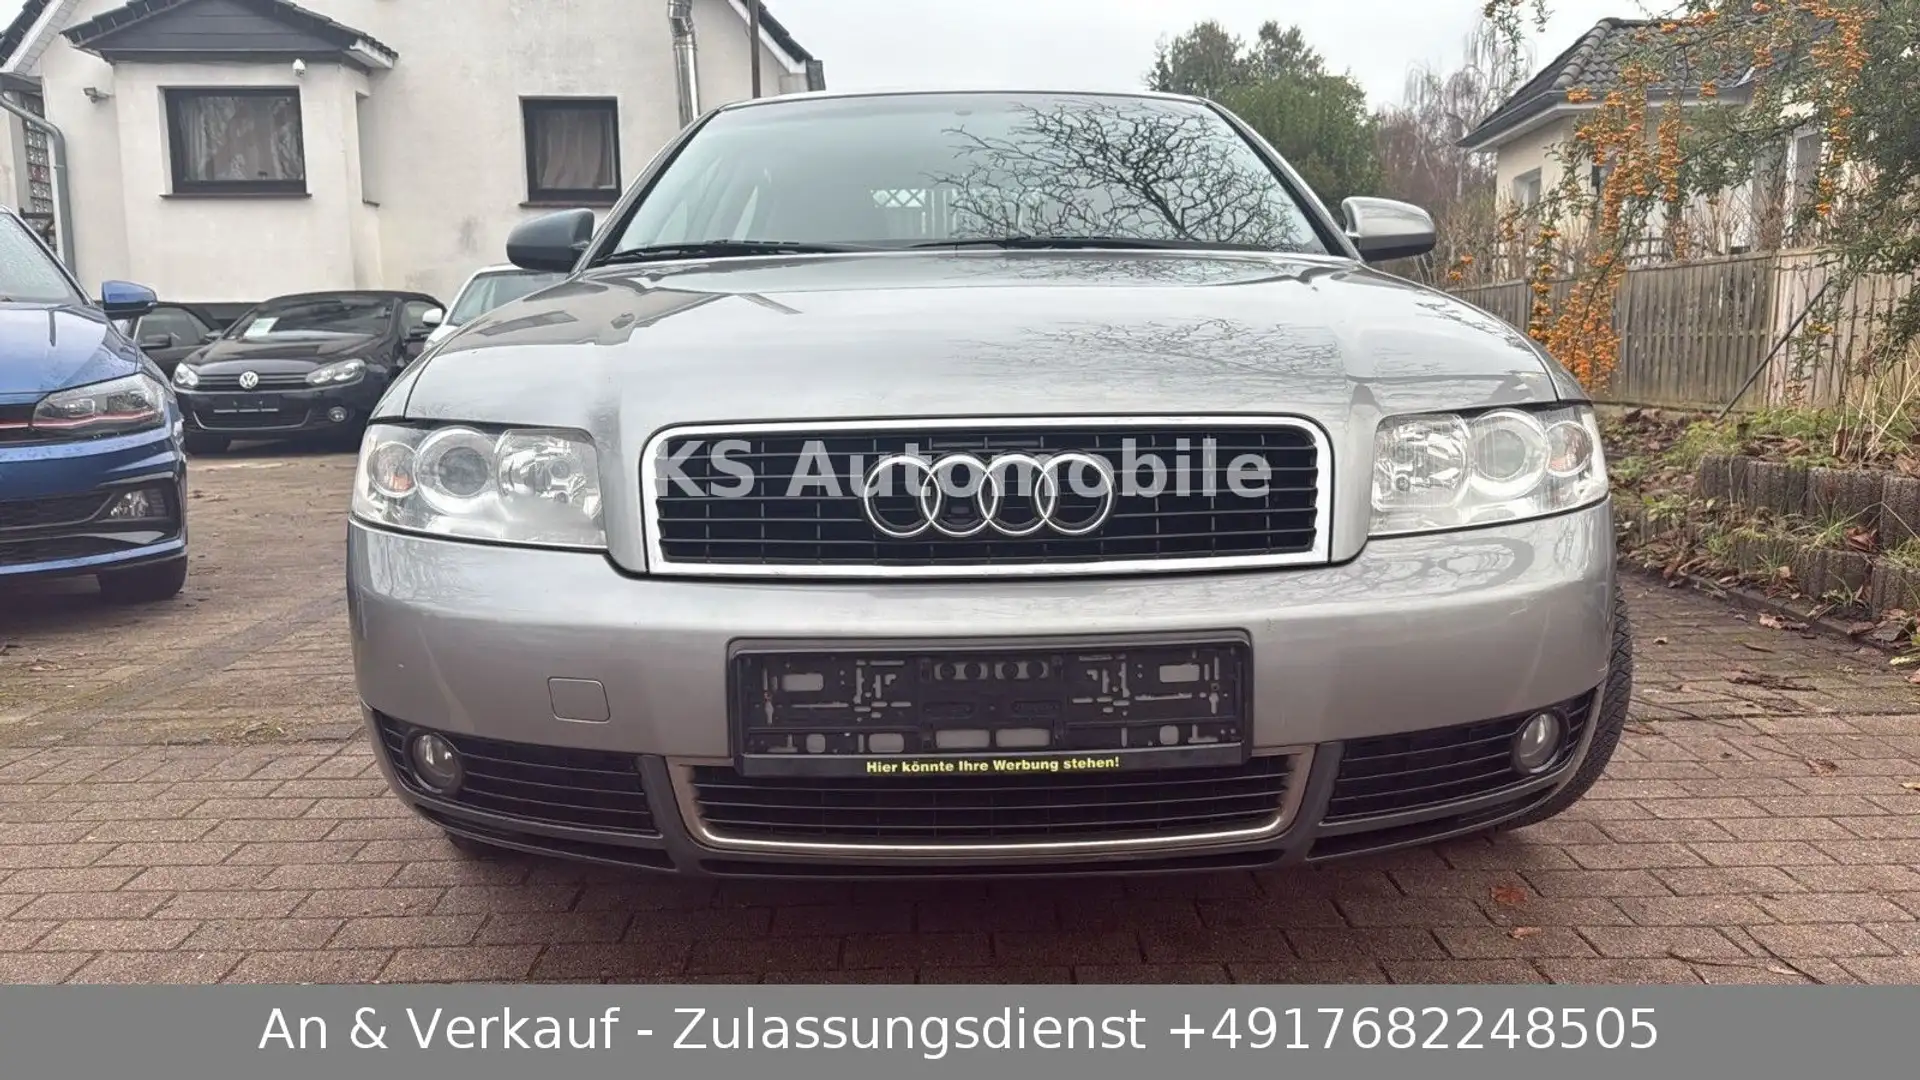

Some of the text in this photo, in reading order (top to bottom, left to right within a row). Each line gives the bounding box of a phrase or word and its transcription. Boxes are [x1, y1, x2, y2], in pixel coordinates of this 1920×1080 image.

[866, 756, 1120, 773] Hier könnte Ihre Werbung stehen!
